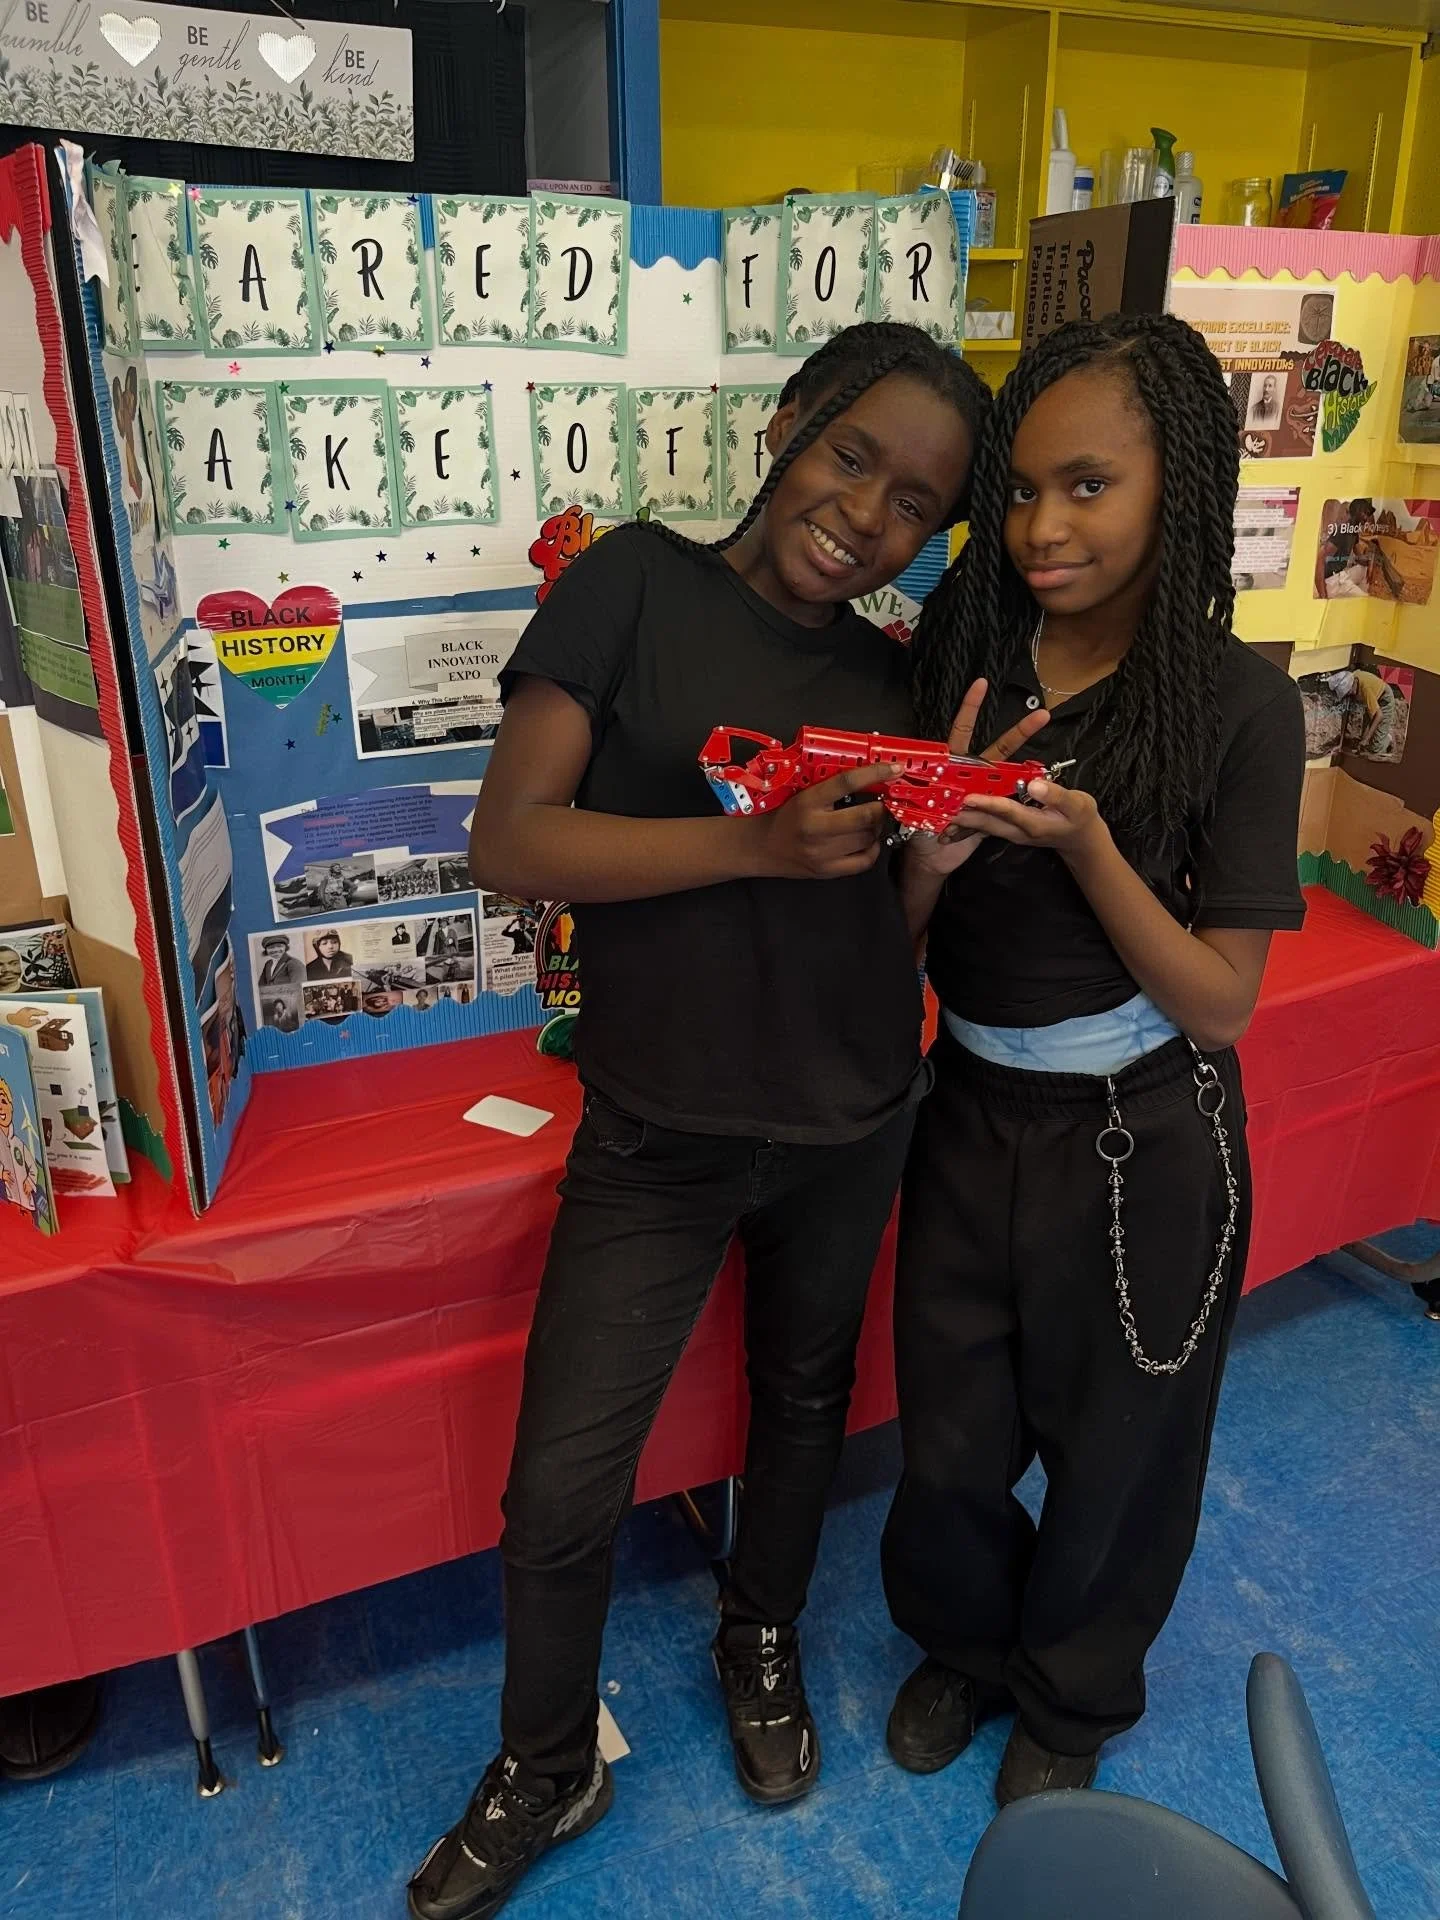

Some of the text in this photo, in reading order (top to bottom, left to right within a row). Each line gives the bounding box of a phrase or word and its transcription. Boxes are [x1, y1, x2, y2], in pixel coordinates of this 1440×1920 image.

[26, 1, 49, 24] BE
[188, 26, 208, 46] BE
[173, 20, 251, 84] gentle
[323, 33, 380, 88] kind
[345, 49, 365, 69] BE
[549, 183, 569, 191] UPON
[741, 242, 932, 309] FOR
[1041, 242, 1057, 326] Triptico
[1055, 240, 1072, 325] Tri-Fold
[1026, 244, 1043, 338] Panneau
[1234, 359, 1295, 371] INNOVATORS
[1305, 355, 1368, 397] Black
[566, 422, 768, 479] OFF
[1340, 523, 1362, 534] Black
[858, 591, 903, 617] WE
[231, 607, 313, 629] BLACK
[221, 633, 326, 658] HISTORY
[441, 640, 484, 653] BLACK
[428, 654, 500, 669] INNOVATOR
[250, 674, 307, 689] MONTH
[449, 670, 481, 682] EXPO
[549, 955, 580, 971] BLA
